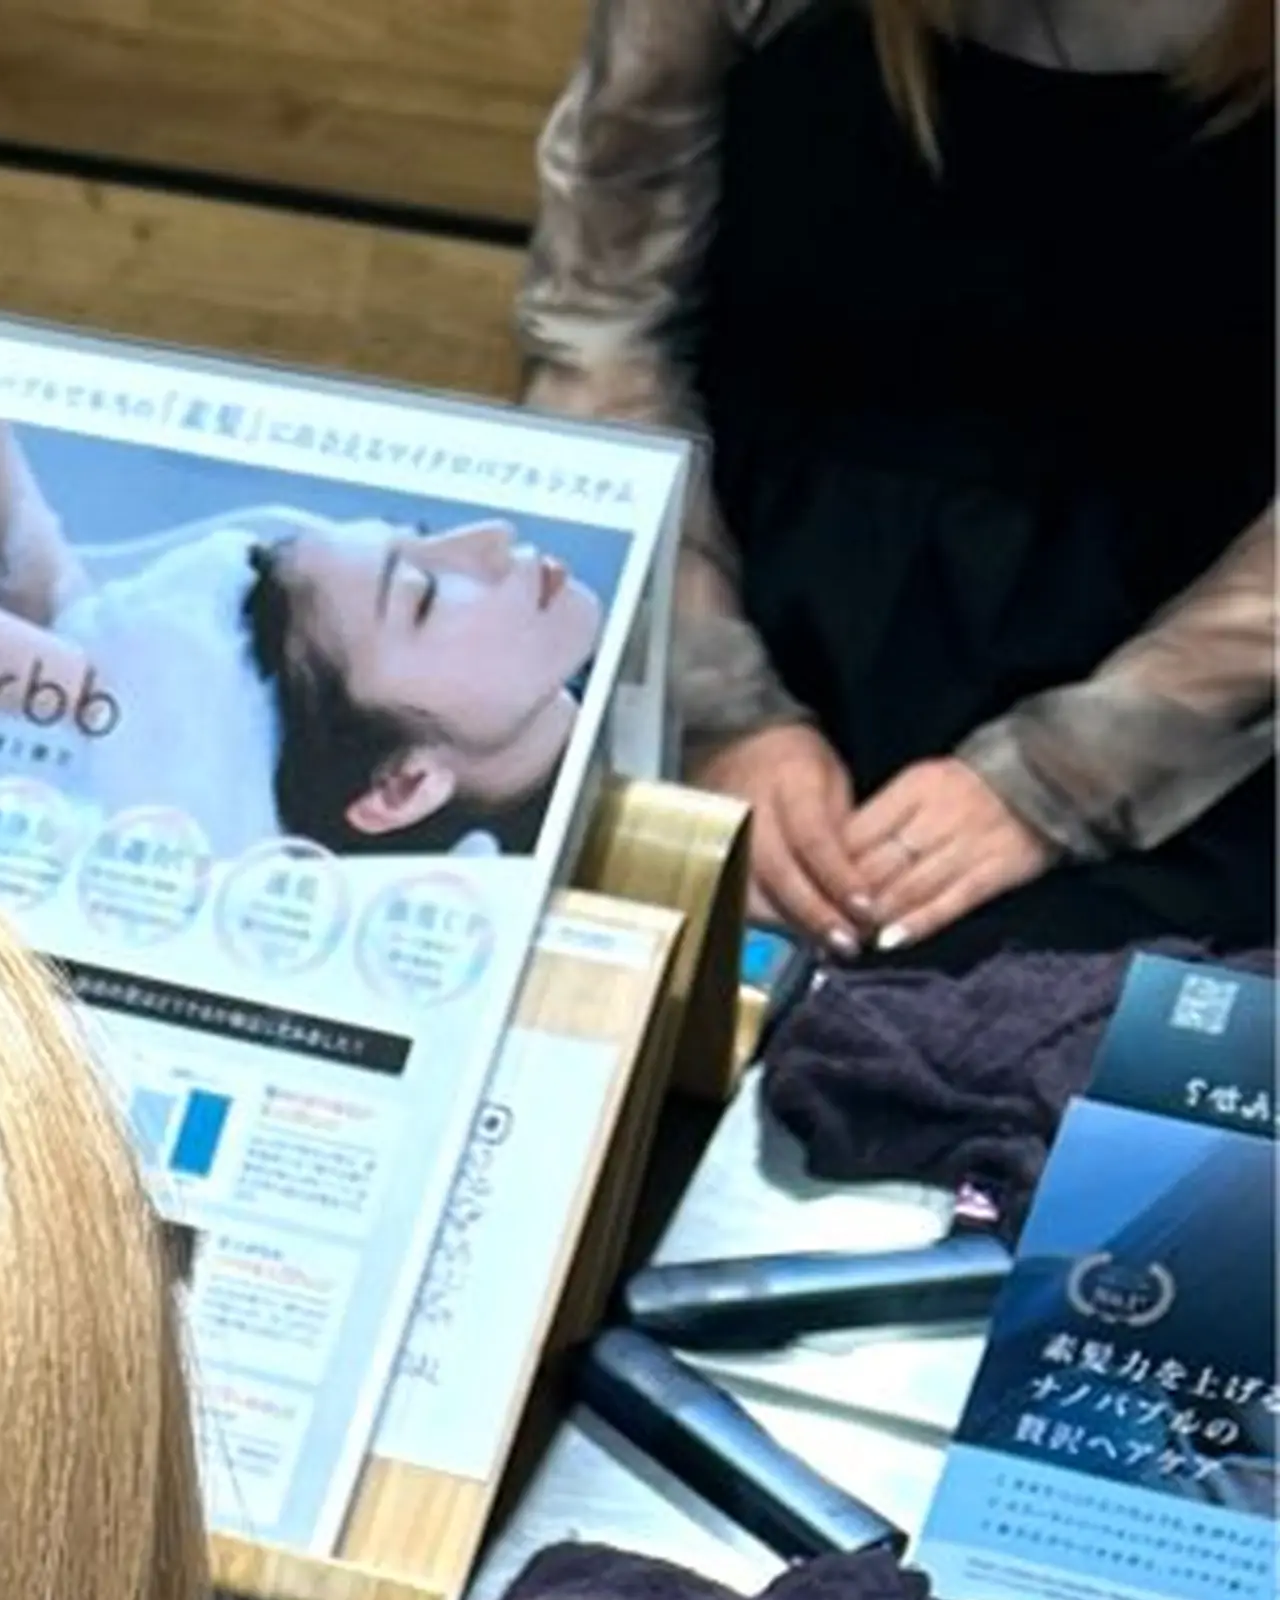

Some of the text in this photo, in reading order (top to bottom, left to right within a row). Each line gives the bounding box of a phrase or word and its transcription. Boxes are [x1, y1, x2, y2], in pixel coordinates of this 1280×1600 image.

[1031, 1373, 1239, 1446] ナノバブルの
